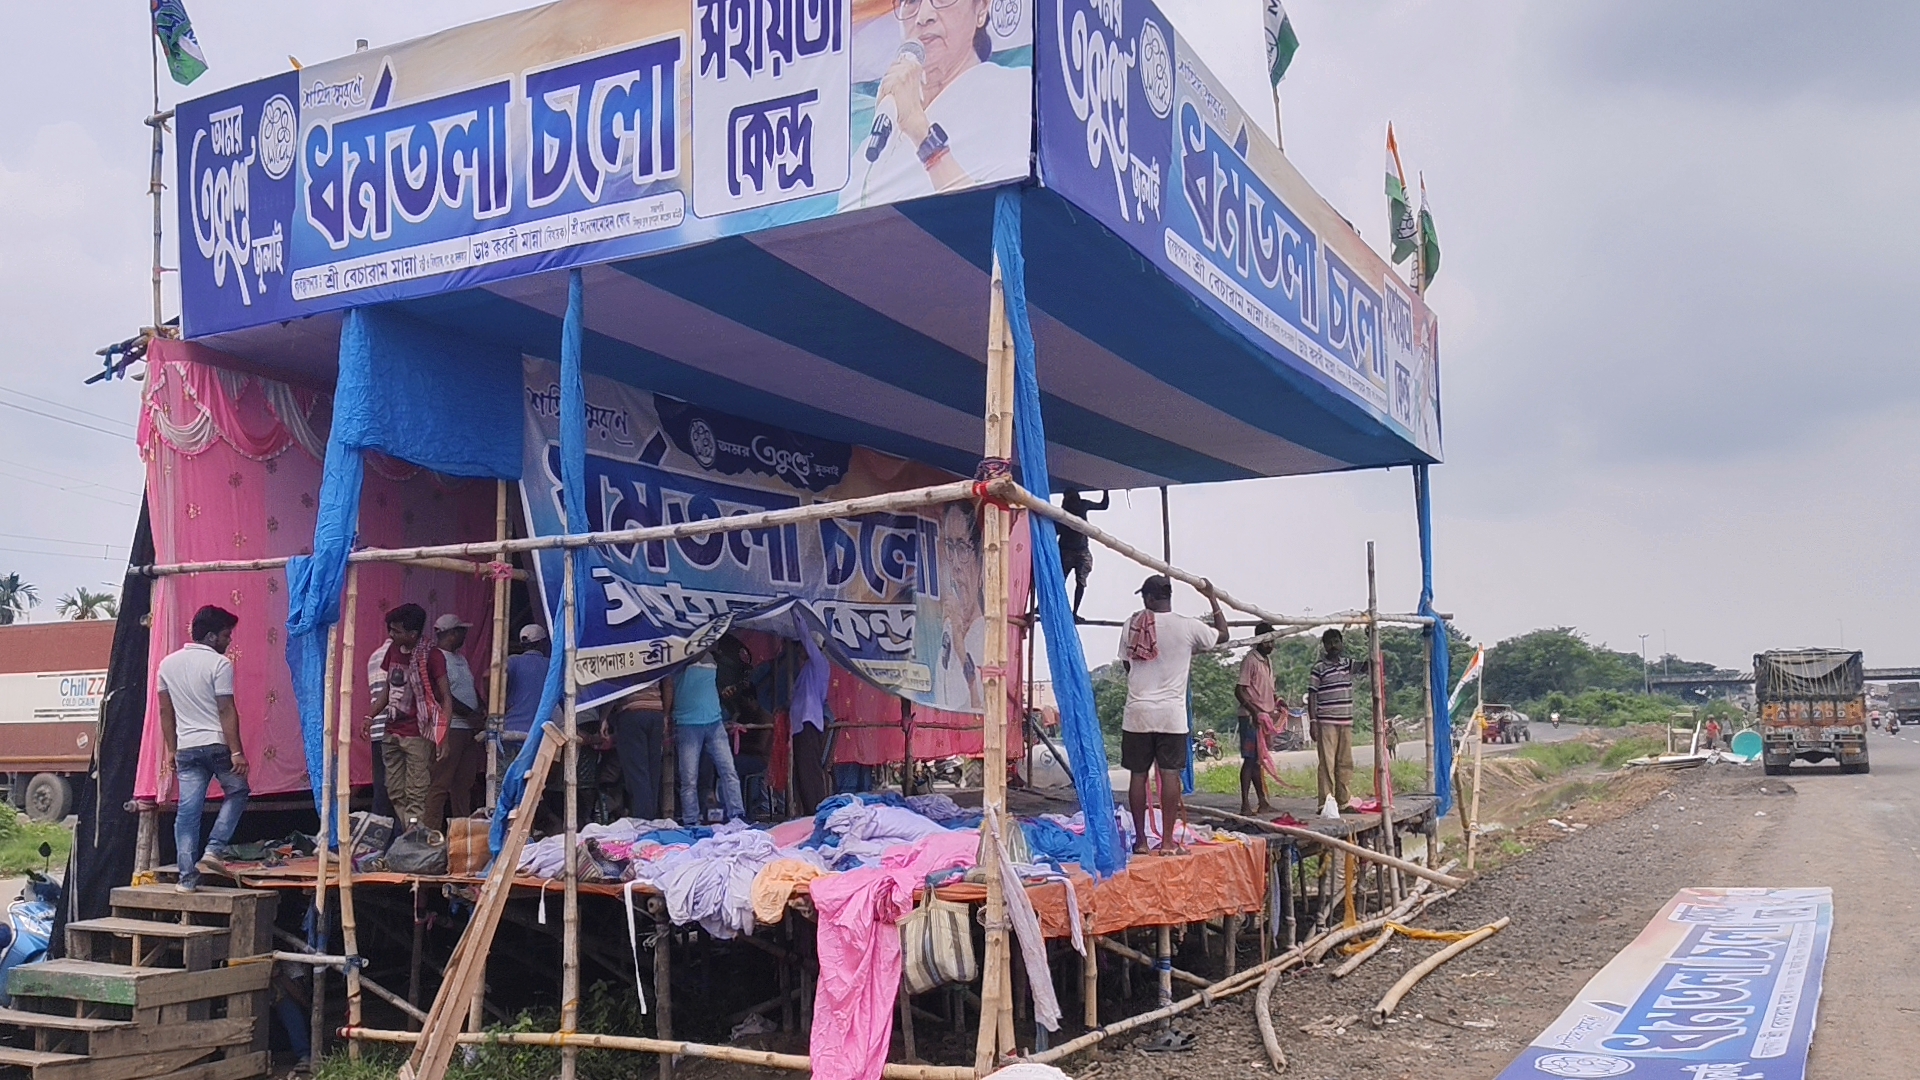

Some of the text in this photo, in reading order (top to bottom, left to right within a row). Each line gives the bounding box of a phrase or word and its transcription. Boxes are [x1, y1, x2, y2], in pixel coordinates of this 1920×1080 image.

[208, 104, 244, 157] অমর
[306, 31, 687, 250] ধর্মতলা চলো
[727, 88, 820, 197] কেন্দ্র
[190, 128, 256, 306] একুশে
[1129, 152, 1161, 224] জুলাই
[252, 219, 284, 295] জুলাই
[323, 264, 339, 291] শ্রী
[344, 262, 388, 288] বেচারাম
[391, 253, 417, 277] মান্না
[492, 228, 518, 257] করবী
[521, 228, 542, 250] মান্না
[1180, 99, 1387, 381] ধর্মতলা চলো
[716, 439, 750, 458] অমর
[751, 434, 815, 486] একুশে
[812, 498, 942, 600] চলো
[60, 677, 105, 696] ChillZZ
[638, 640, 673, 667] শ্রী
